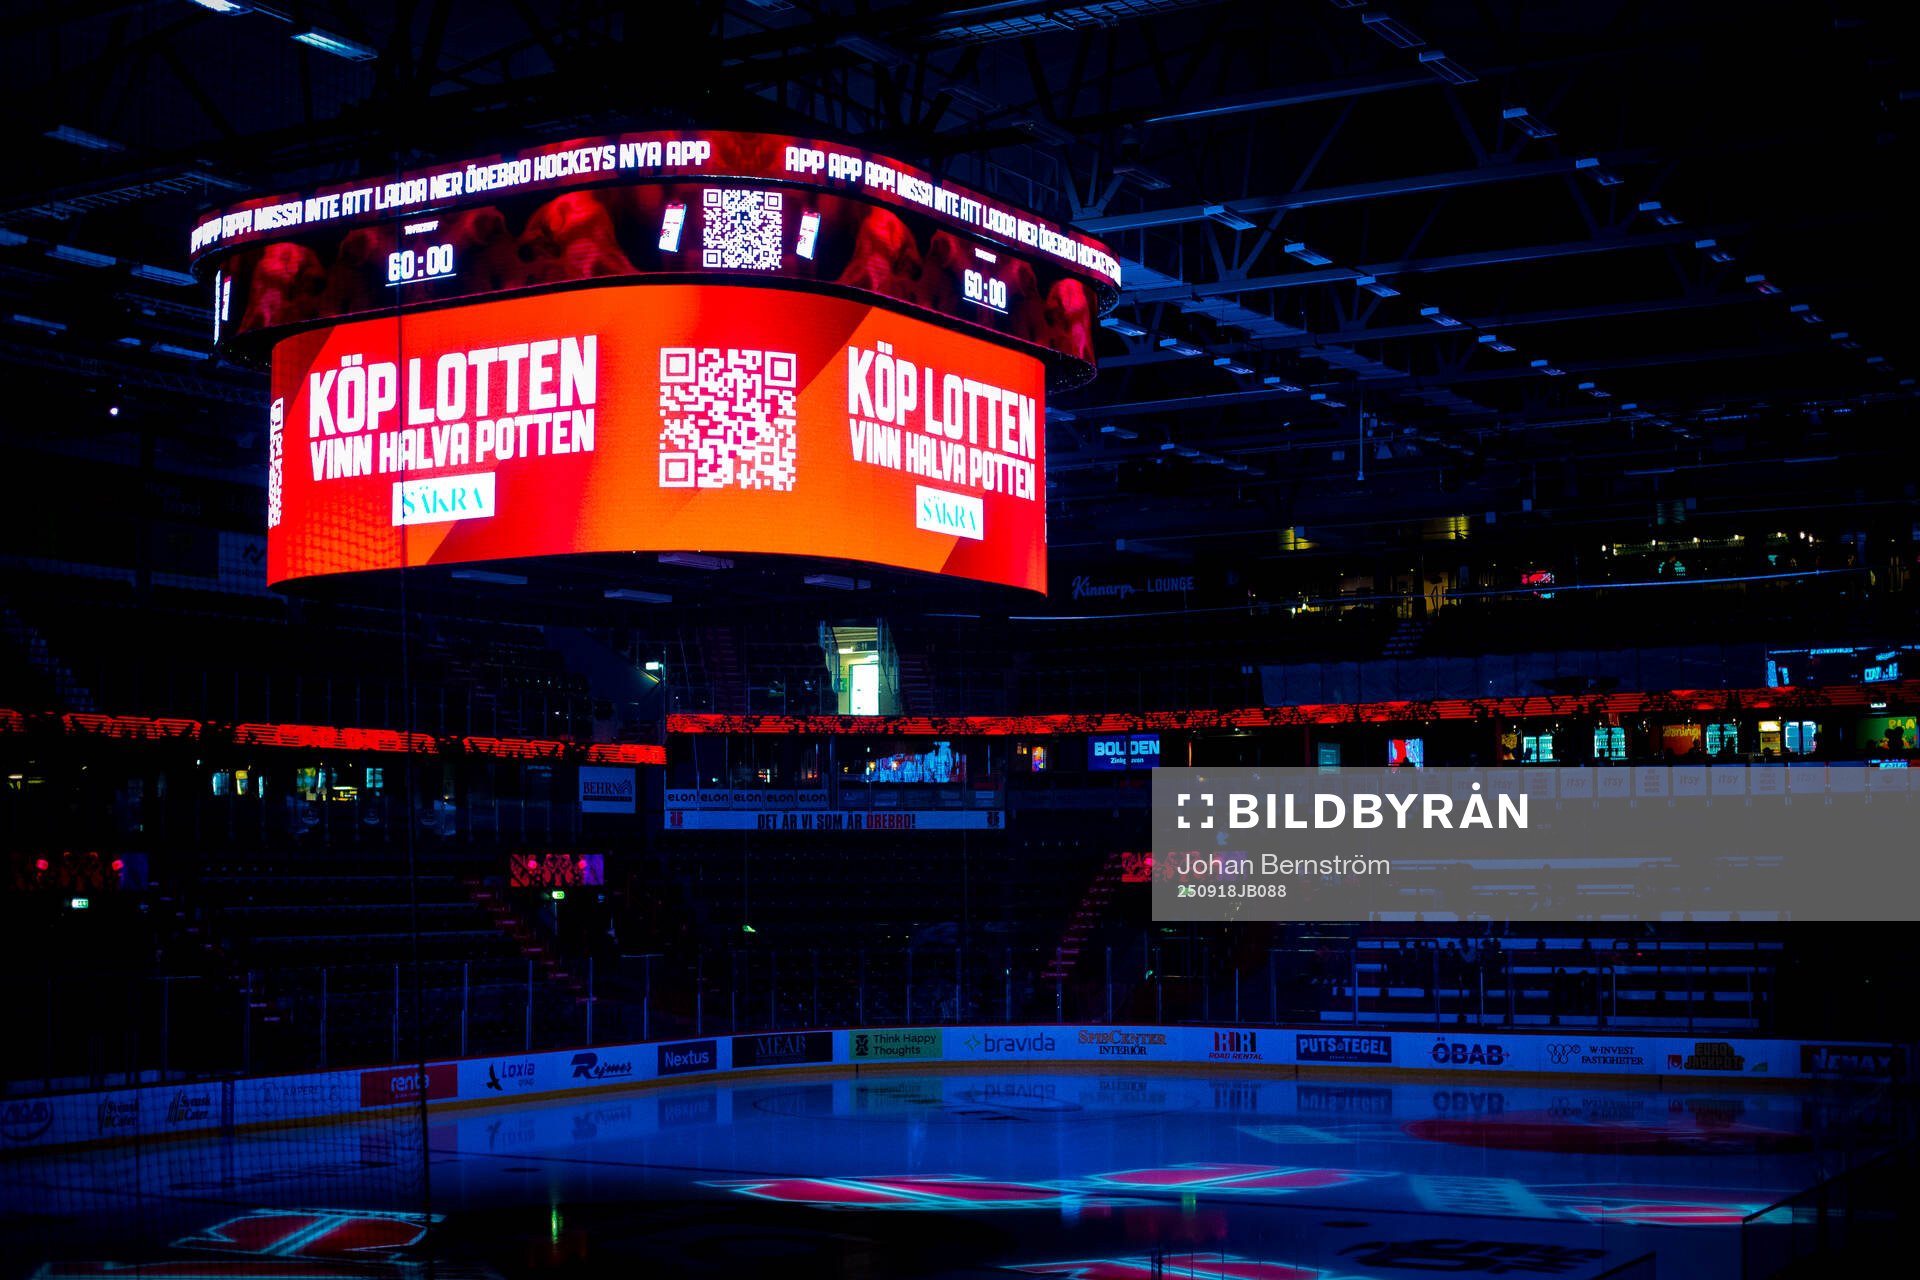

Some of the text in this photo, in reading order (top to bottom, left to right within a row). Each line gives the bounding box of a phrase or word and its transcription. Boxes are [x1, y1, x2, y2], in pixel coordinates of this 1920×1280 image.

[222, 210, 253, 239] APP!
[254, 201, 303, 231] MISSA
[305, 194, 340, 222] INTE
[342, 186, 374, 217] ATT
[375, 177, 427, 210] LADDA
[430, 170, 463, 200] NER
[465, 158, 531, 194] ÖREBRO
[534, 144, 616, 182] HOCKEYS
[619, 140, 662, 170] NYA
[666, 140, 711, 167] APP
[785, 146, 825, 176] APP
[828, 151, 863, 183] APP
[865, 160, 896, 193] APP!
[897, 172, 933, 208] MISSA
[934, 186, 959, 218] INTE
[960, 193, 982, 226] ATT
[982, 200, 1017, 240] LADDA
[1017, 213, 1038, 247] NER
[1038, 218, 1077, 263] ÖREBRO
[388, 244, 454, 282] 60:00
[964, 269, 1007, 309] 60:00
[309, 334, 597, 438] KÖP LOTTEN
[848, 340, 1036, 460] KÖP LOTTEN
[310, 409, 595, 481] VINN HALVA POTTEN
[850, 418, 1035, 501] VINN HALVA POTTEN
[402, 486, 484, 515] SÄKRA
[923, 496, 976, 531] SÄKRA
[1147, 576, 1195, 593] LOUNGE
[757, 811, 917, 830] DET ÄR VI SOM ÄR ÖREBRO!
[874, 1033, 936, 1045] Think Happy
[874, 1045, 921, 1056] Thoughts
[984, 1032, 1056, 1054] bravida
[1099, 1044, 1146, 1055] INTERIÖR
[1432, 1037, 1503, 1065] ÖBAB
[502, 1059, 535, 1078] Loxia
[665, 1050, 709, 1068] Nextus
[1582, 1056, 1644, 1065] FASTIGHETER
